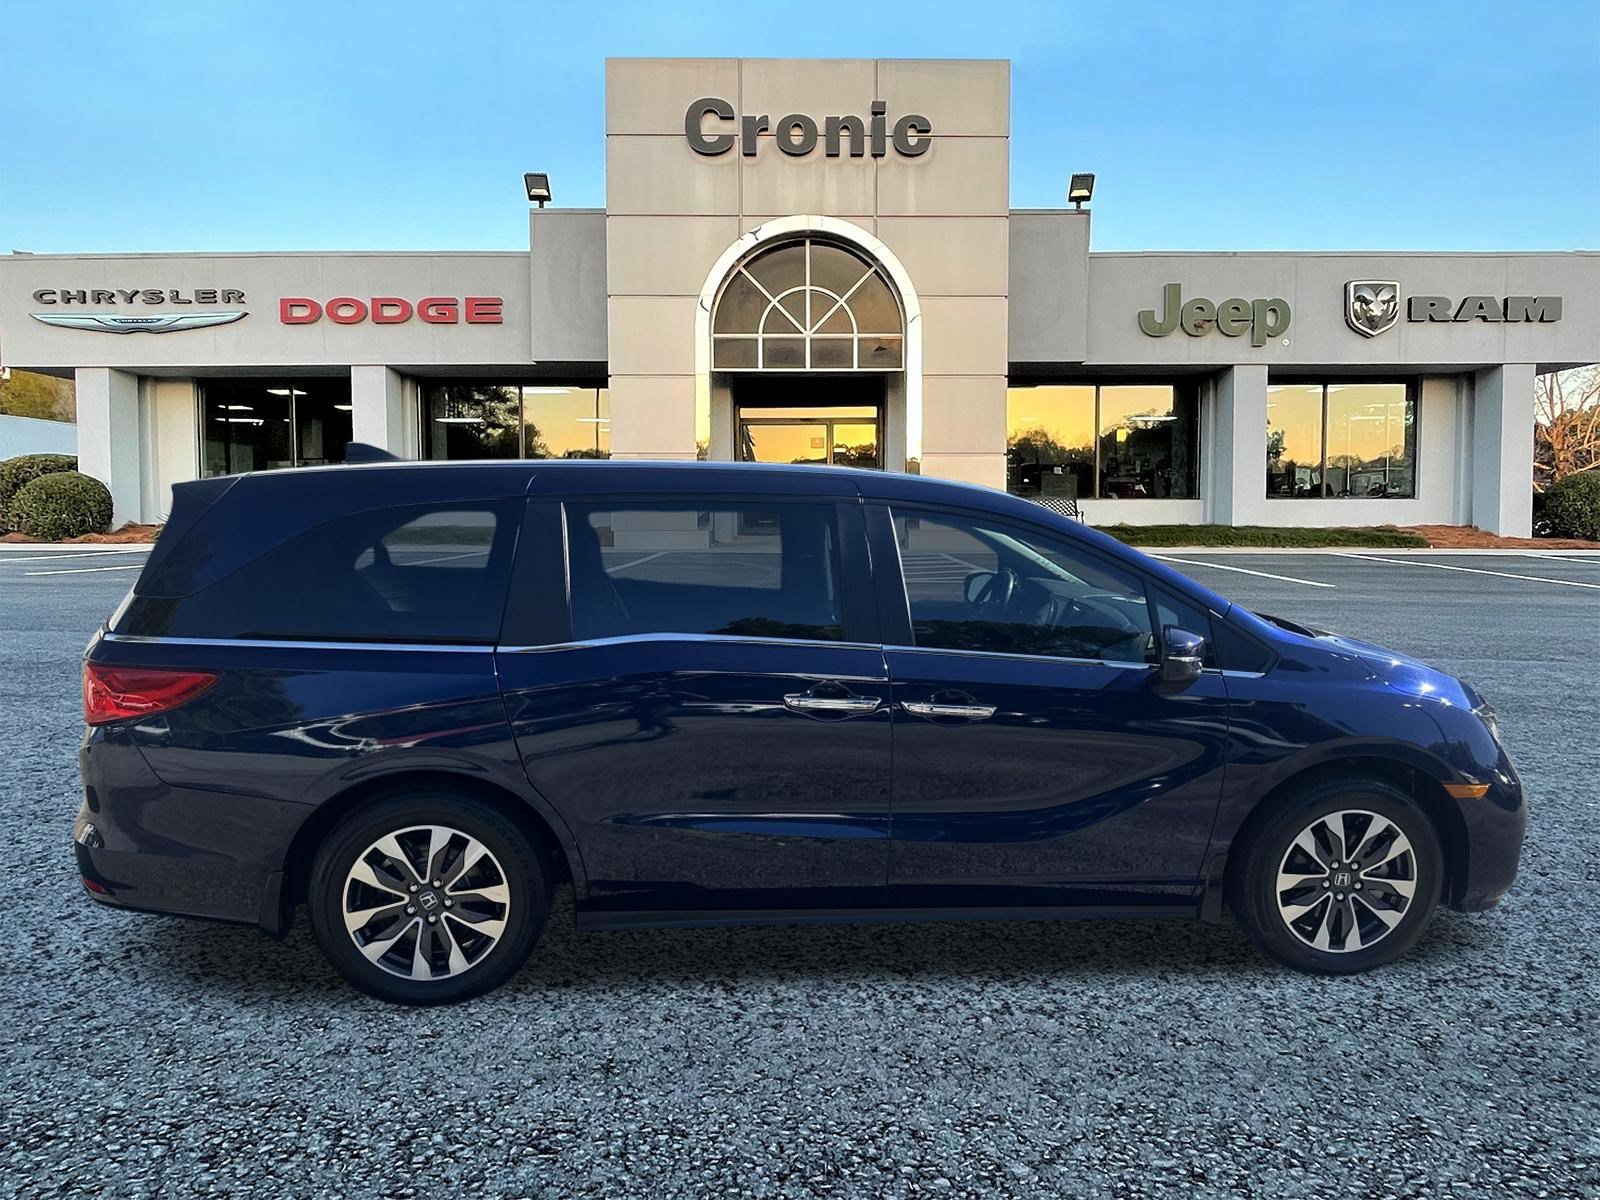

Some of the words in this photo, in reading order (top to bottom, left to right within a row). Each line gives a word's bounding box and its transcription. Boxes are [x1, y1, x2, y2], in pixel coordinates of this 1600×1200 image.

[685, 97, 932, 157] Cronic
[32, 288, 247, 305] CHRYSLER
[280, 296, 504, 326] DODGE
[1407, 296, 1563, 323] RAM
[1138, 283, 1292, 347] Jeep
